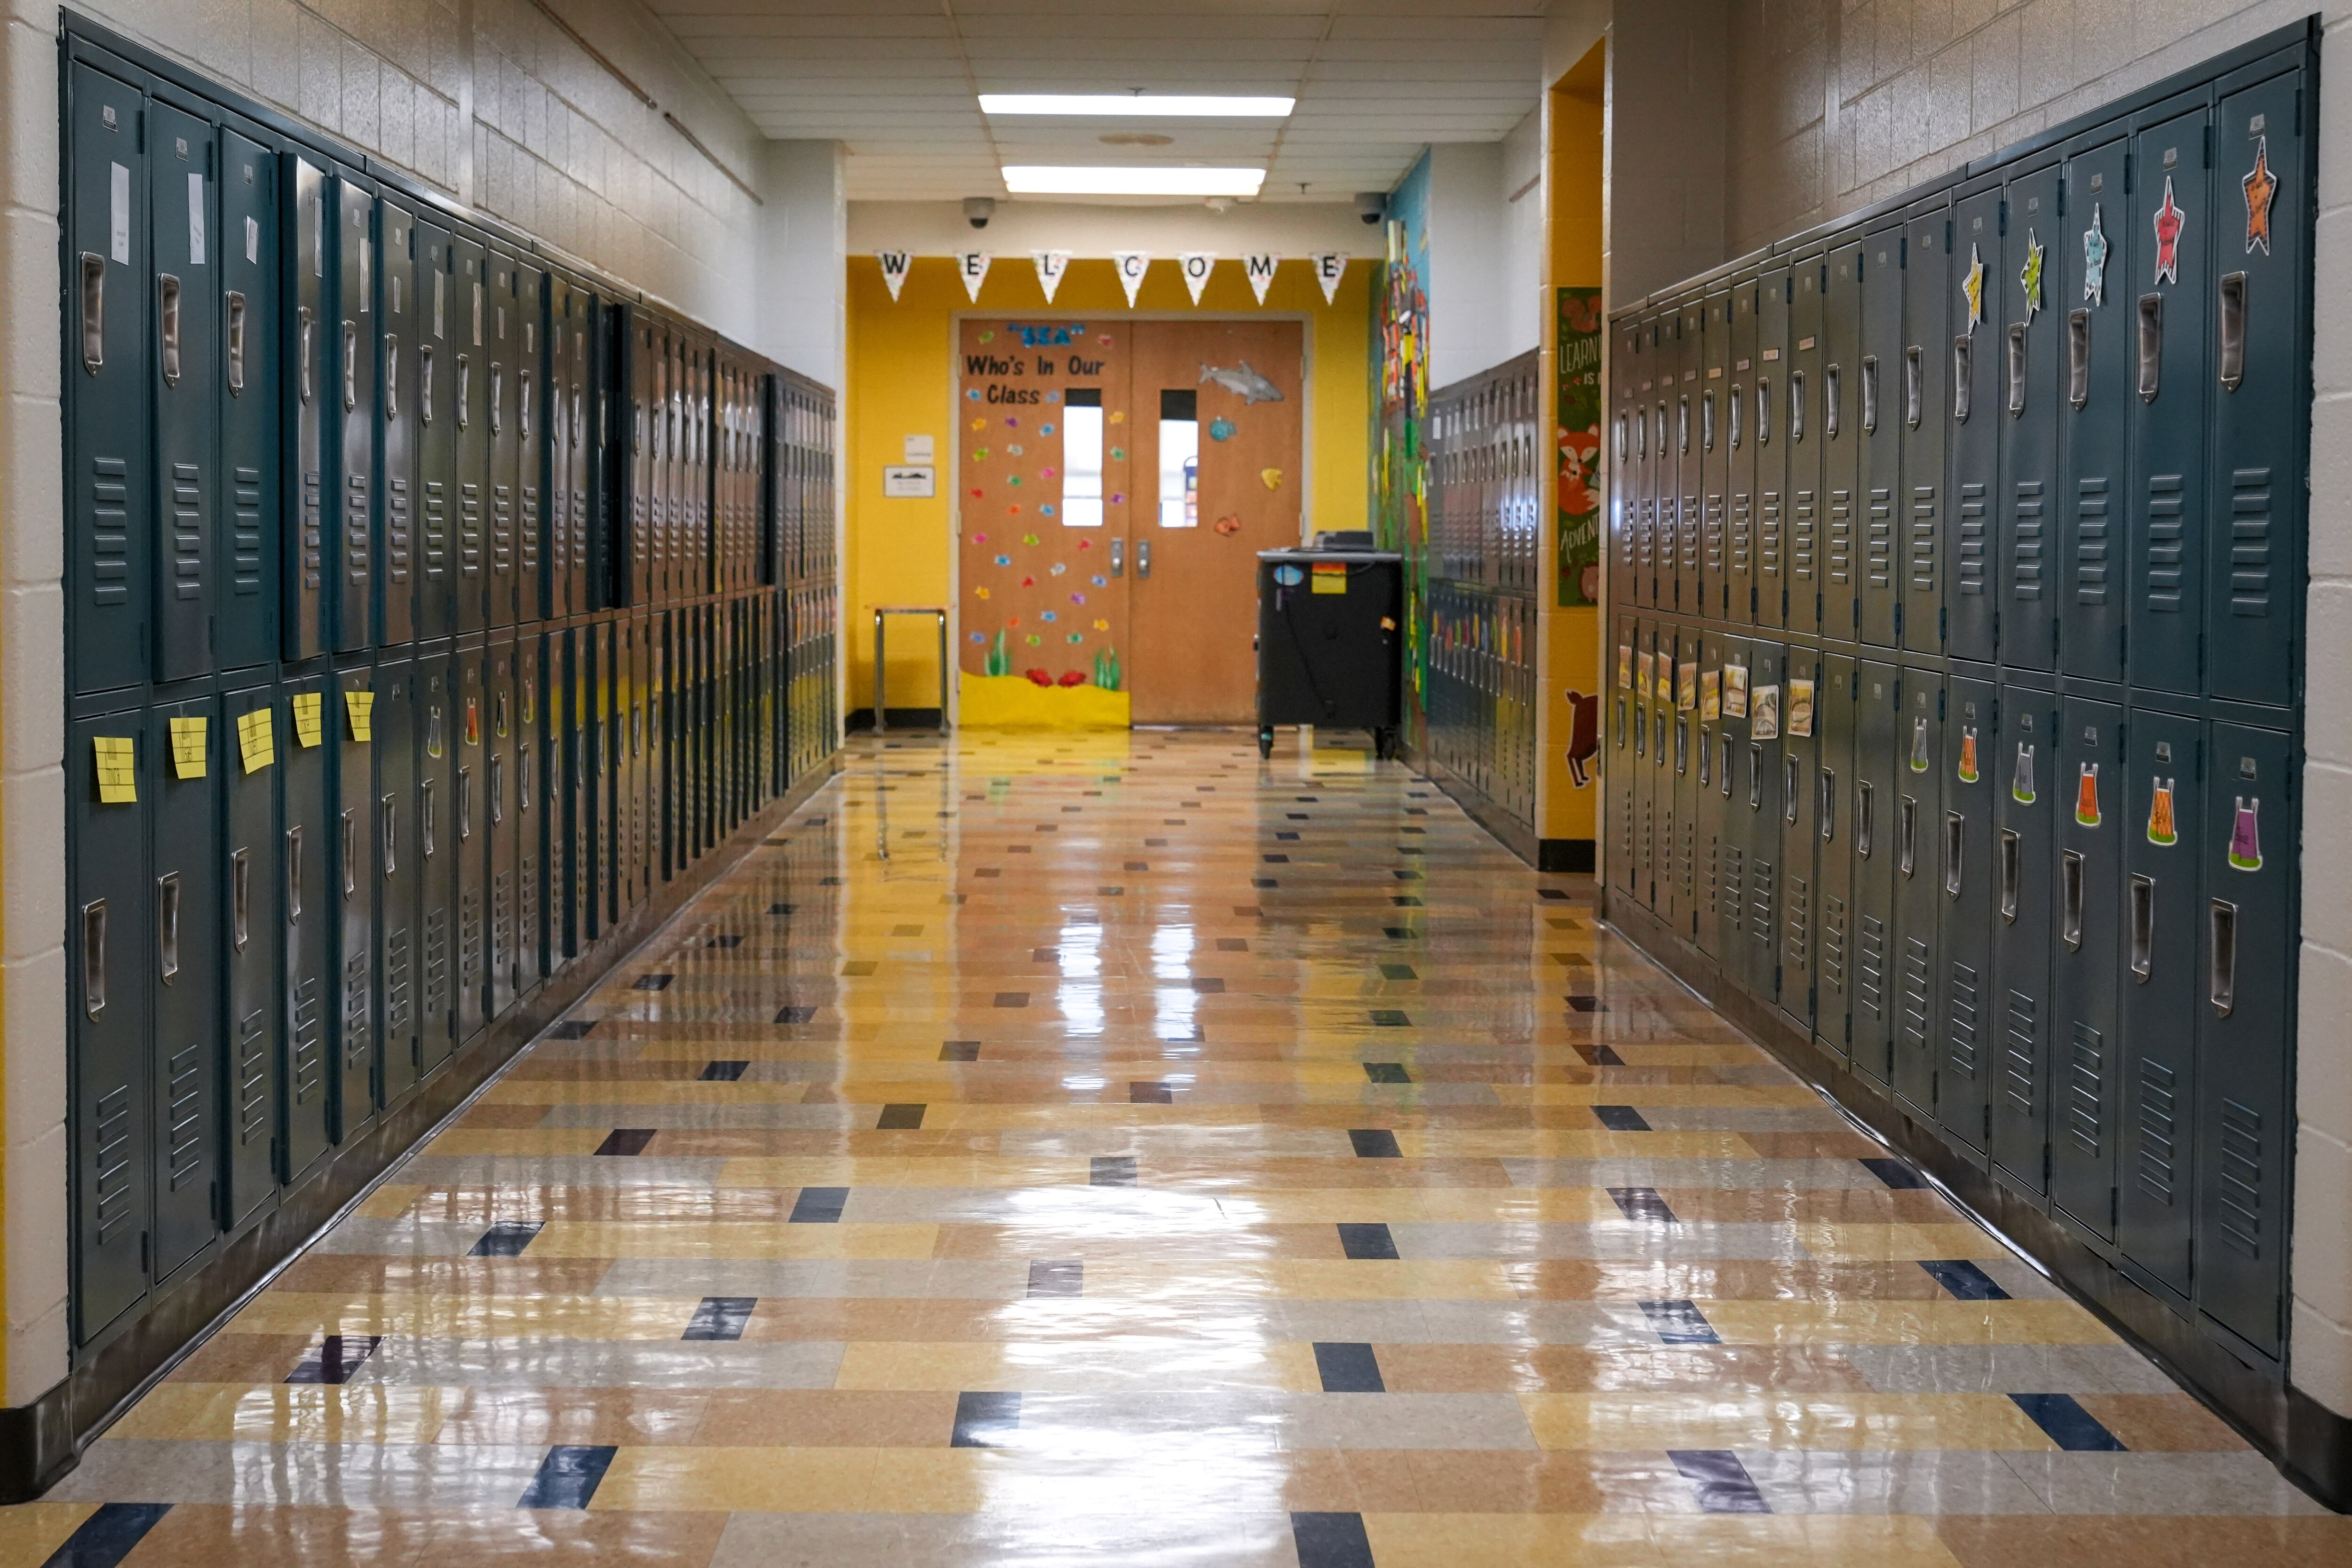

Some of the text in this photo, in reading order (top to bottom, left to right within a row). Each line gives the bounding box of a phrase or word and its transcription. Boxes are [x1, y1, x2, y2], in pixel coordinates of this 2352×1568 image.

[967, 355, 1104, 376] Who's In Our
[1583, 372, 1595, 385] IS
[987, 384, 1041, 404] Class
